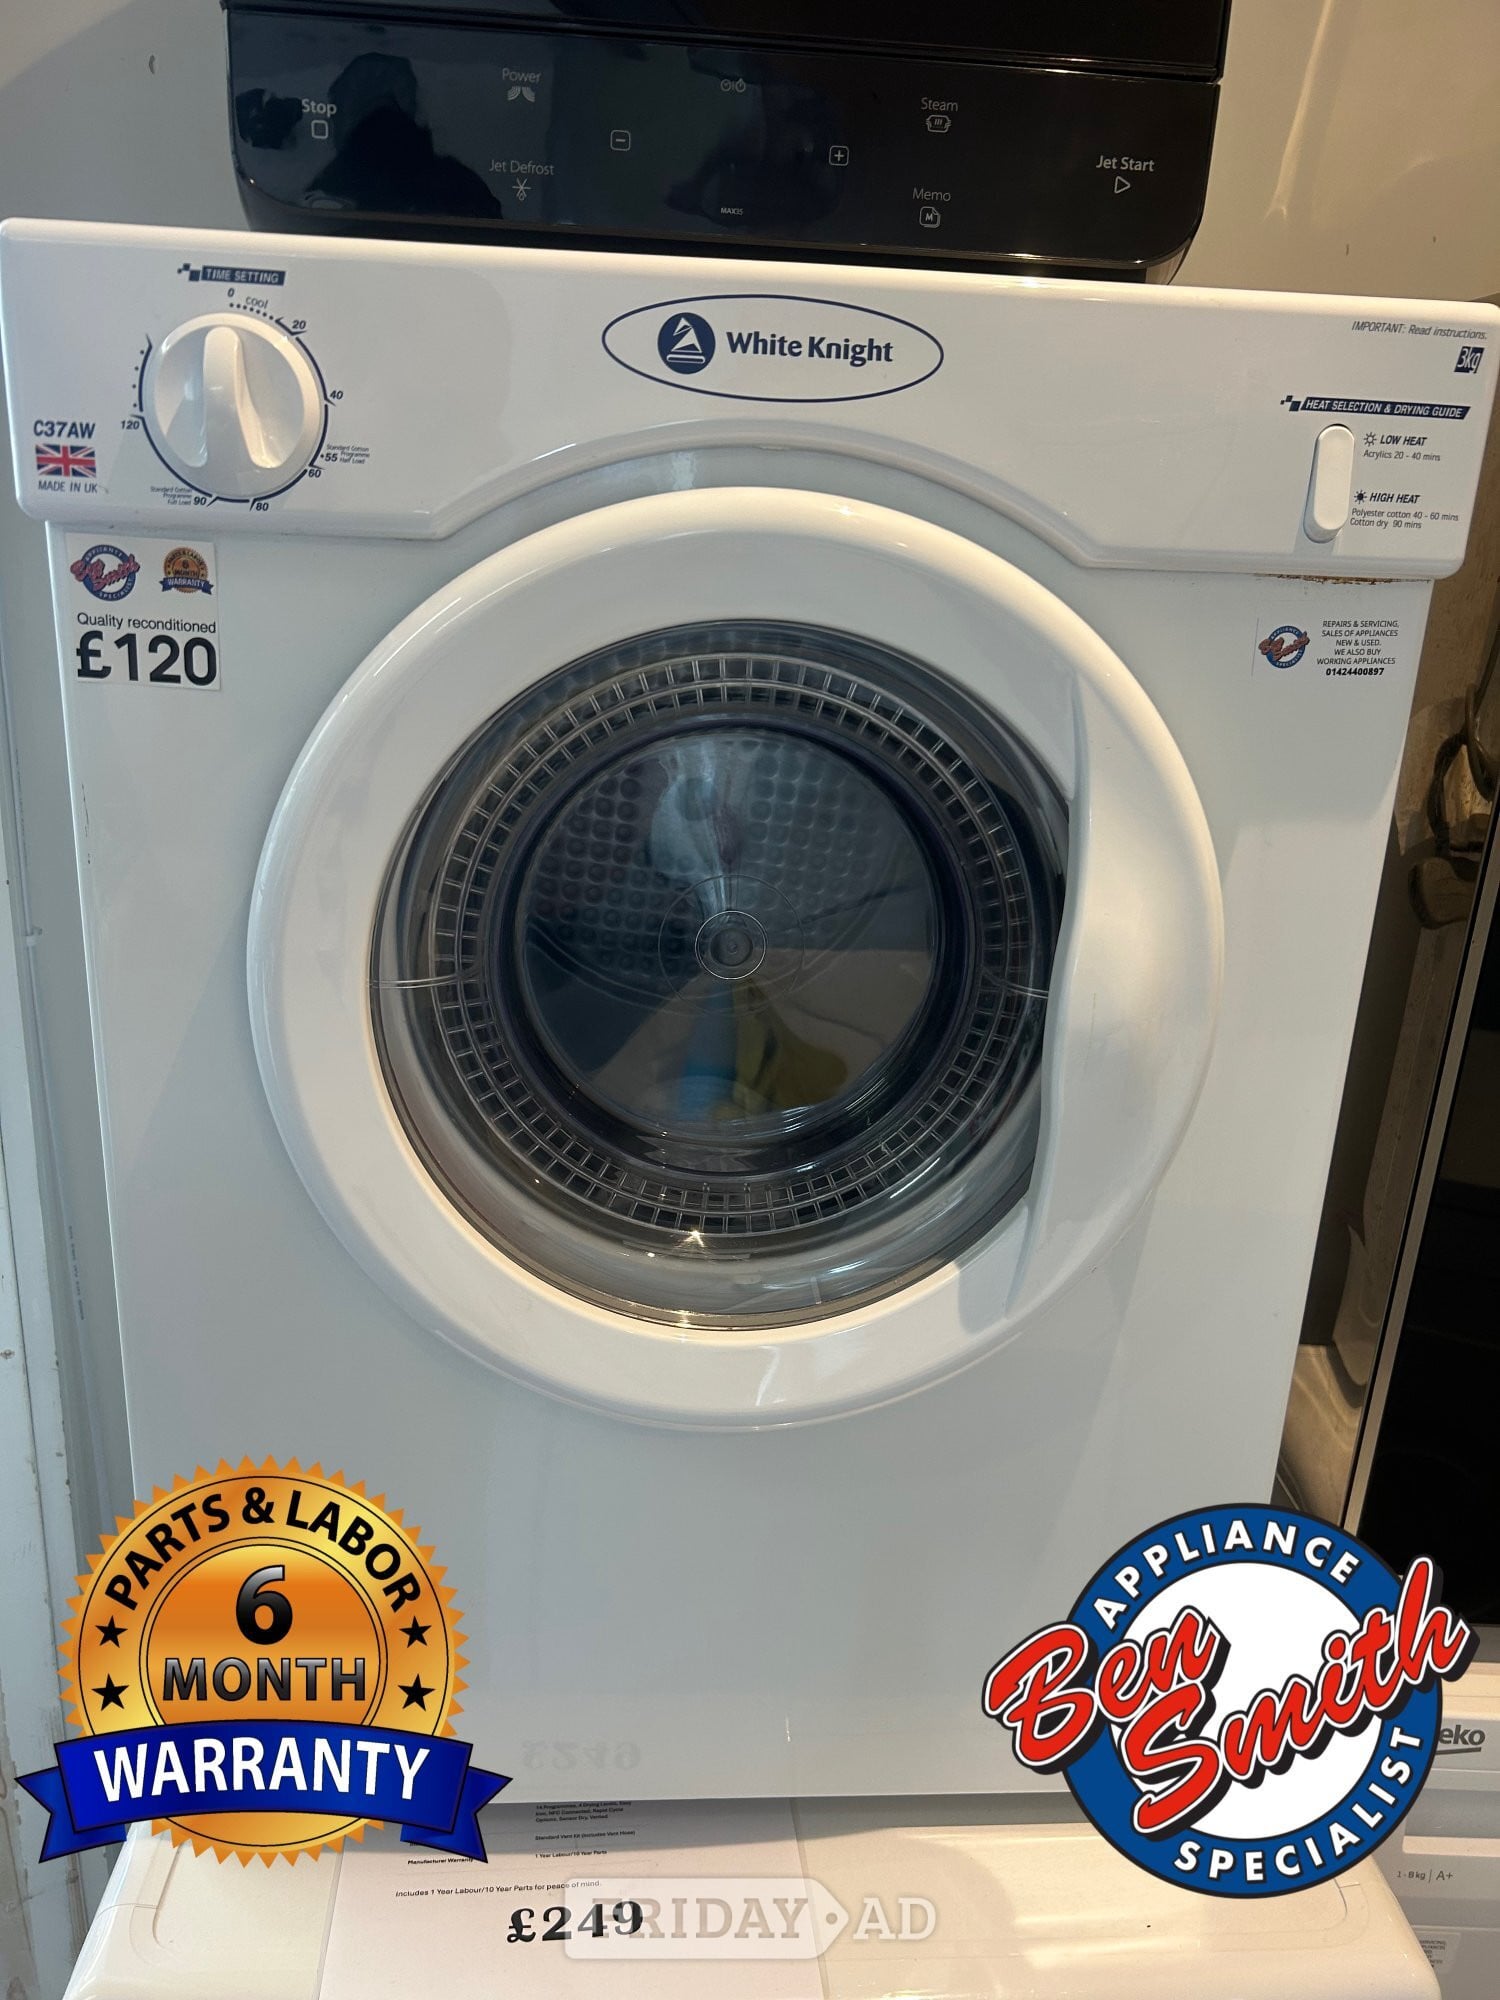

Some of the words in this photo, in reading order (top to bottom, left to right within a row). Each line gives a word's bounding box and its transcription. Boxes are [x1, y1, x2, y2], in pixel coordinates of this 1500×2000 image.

[502, 67, 541, 83] Power
[301, 99, 337, 117] Stop
[921, 97, 958, 112] Steam
[489, 160, 506, 173] Jet
[510, 160, 555, 176] Defrost
[1096, 156, 1117, 169] Jet
[1120, 157, 1155, 172] Start
[912, 187, 951, 202] Memo
[206, 268, 231, 280] TIME
[234, 271, 279, 284] SETTING
[227, 287, 235, 298] 0
[245, 296, 269, 309] cool
[292, 319, 307, 331] 20
[1352, 321, 1405, 334] IMPORTANT:
[1408, 325, 1432, 336] Read
[1433, 327, 1488, 340] instructions.
[726, 331, 803, 357] White
[807, 336, 894, 367] Knight
[1456, 347, 1482, 374] 3kg
[329, 390, 344, 401] 40
[1306, 400, 1330, 410] HEAT
[1332, 400, 1382, 413] SELECTION
[1384, 405, 1391, 413] &
[1394, 405, 1429, 416] DRYING
[1432, 408, 1464, 418] GUIDE
[33, 419, 96, 440] C37AW
[121, 420, 140, 430] 120
[1380, 435, 1402, 445] LOW
[1403, 436, 1428, 447] HEAT
[325, 453, 338, 463] 55
[1364, 450, 1392, 461] Acrylics
[1394, 451, 1404, 460] 20
[1412, 452, 1422, 461] 40
[1423, 453, 1441, 462] mins
[309, 468, 322, 478] 60
[38, 481, 65, 492] MADE
[69, 482, 81, 492] IN
[84, 483, 98, 494] UK
[193, 496, 207, 506] 90
[1369, 493, 1394, 502] HIGH
[1396, 495, 1421, 504] HEAT
[255, 501, 269, 512] 80
[1351, 508, 1385, 518] Polyester
[1386, 511, 1411, 519] cotton
[1412, 512, 1422, 520] 40
[1429, 513, 1439, 521] 60
[1350, 518, 1375, 526] Cotton
[1376, 518, 1389, 530] dry
[1393, 520, 1402, 528] 90
[1404, 521, 1422, 529] mins
[167, 578, 205, 587] WARRANTY
[77, 612, 123, 630] Quality
[128, 619, 216, 634] reconditioned
[1360, 621, 1399, 629] SERVICING,
[76, 630, 217, 687] £120
[1325, 668, 1385, 676] 01424400897
[1439, 1724, 1486, 1746] eko
[1435, 1870, 1454, 1881] A+
[395, 1889, 429, 1898] Includes
[455, 1886, 494, 1894] Labour/10
[546, 1883, 571, 1891] peace
[506, 1901, 643, 1944] £249
